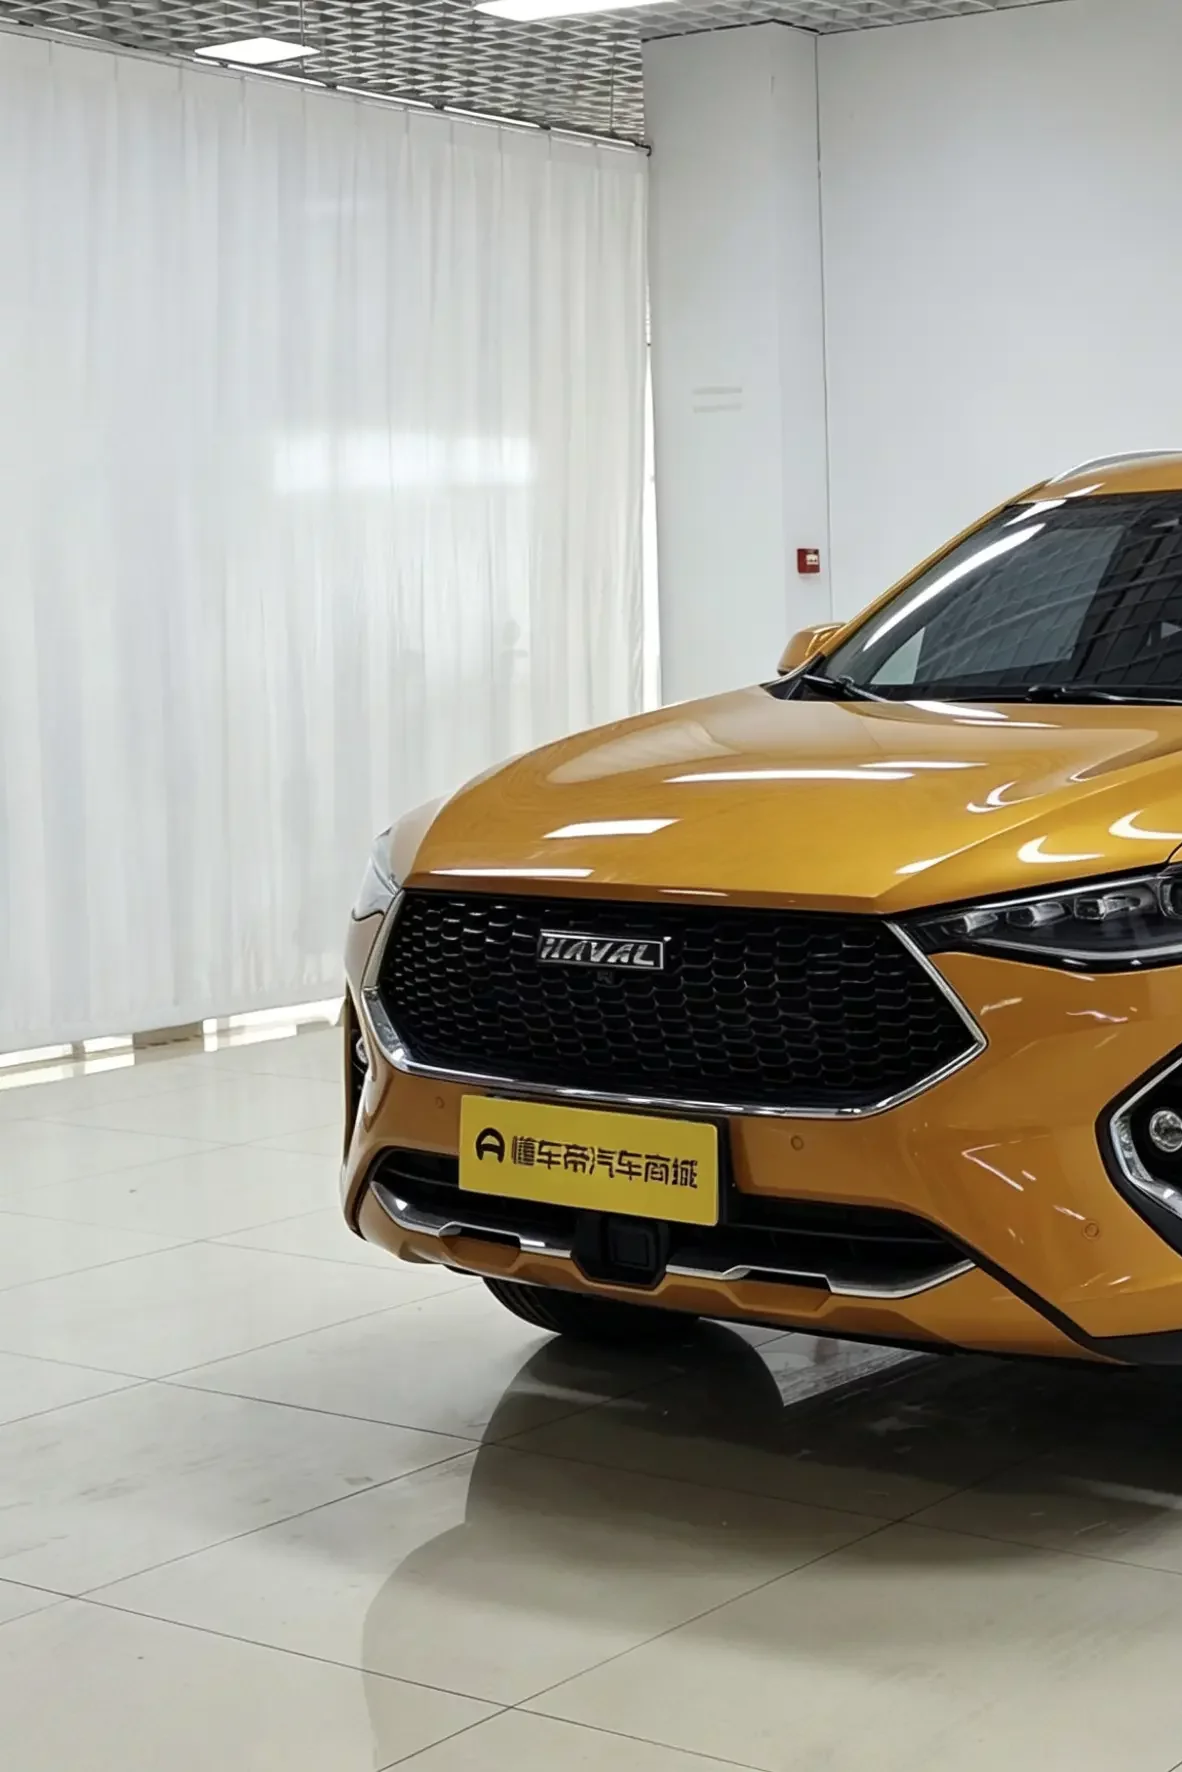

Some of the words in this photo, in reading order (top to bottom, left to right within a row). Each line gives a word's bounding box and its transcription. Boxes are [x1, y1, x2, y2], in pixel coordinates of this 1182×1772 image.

[540, 937, 655, 966] HAVAL
[511, 1135, 698, 1189] 懂车帝汽车商城
